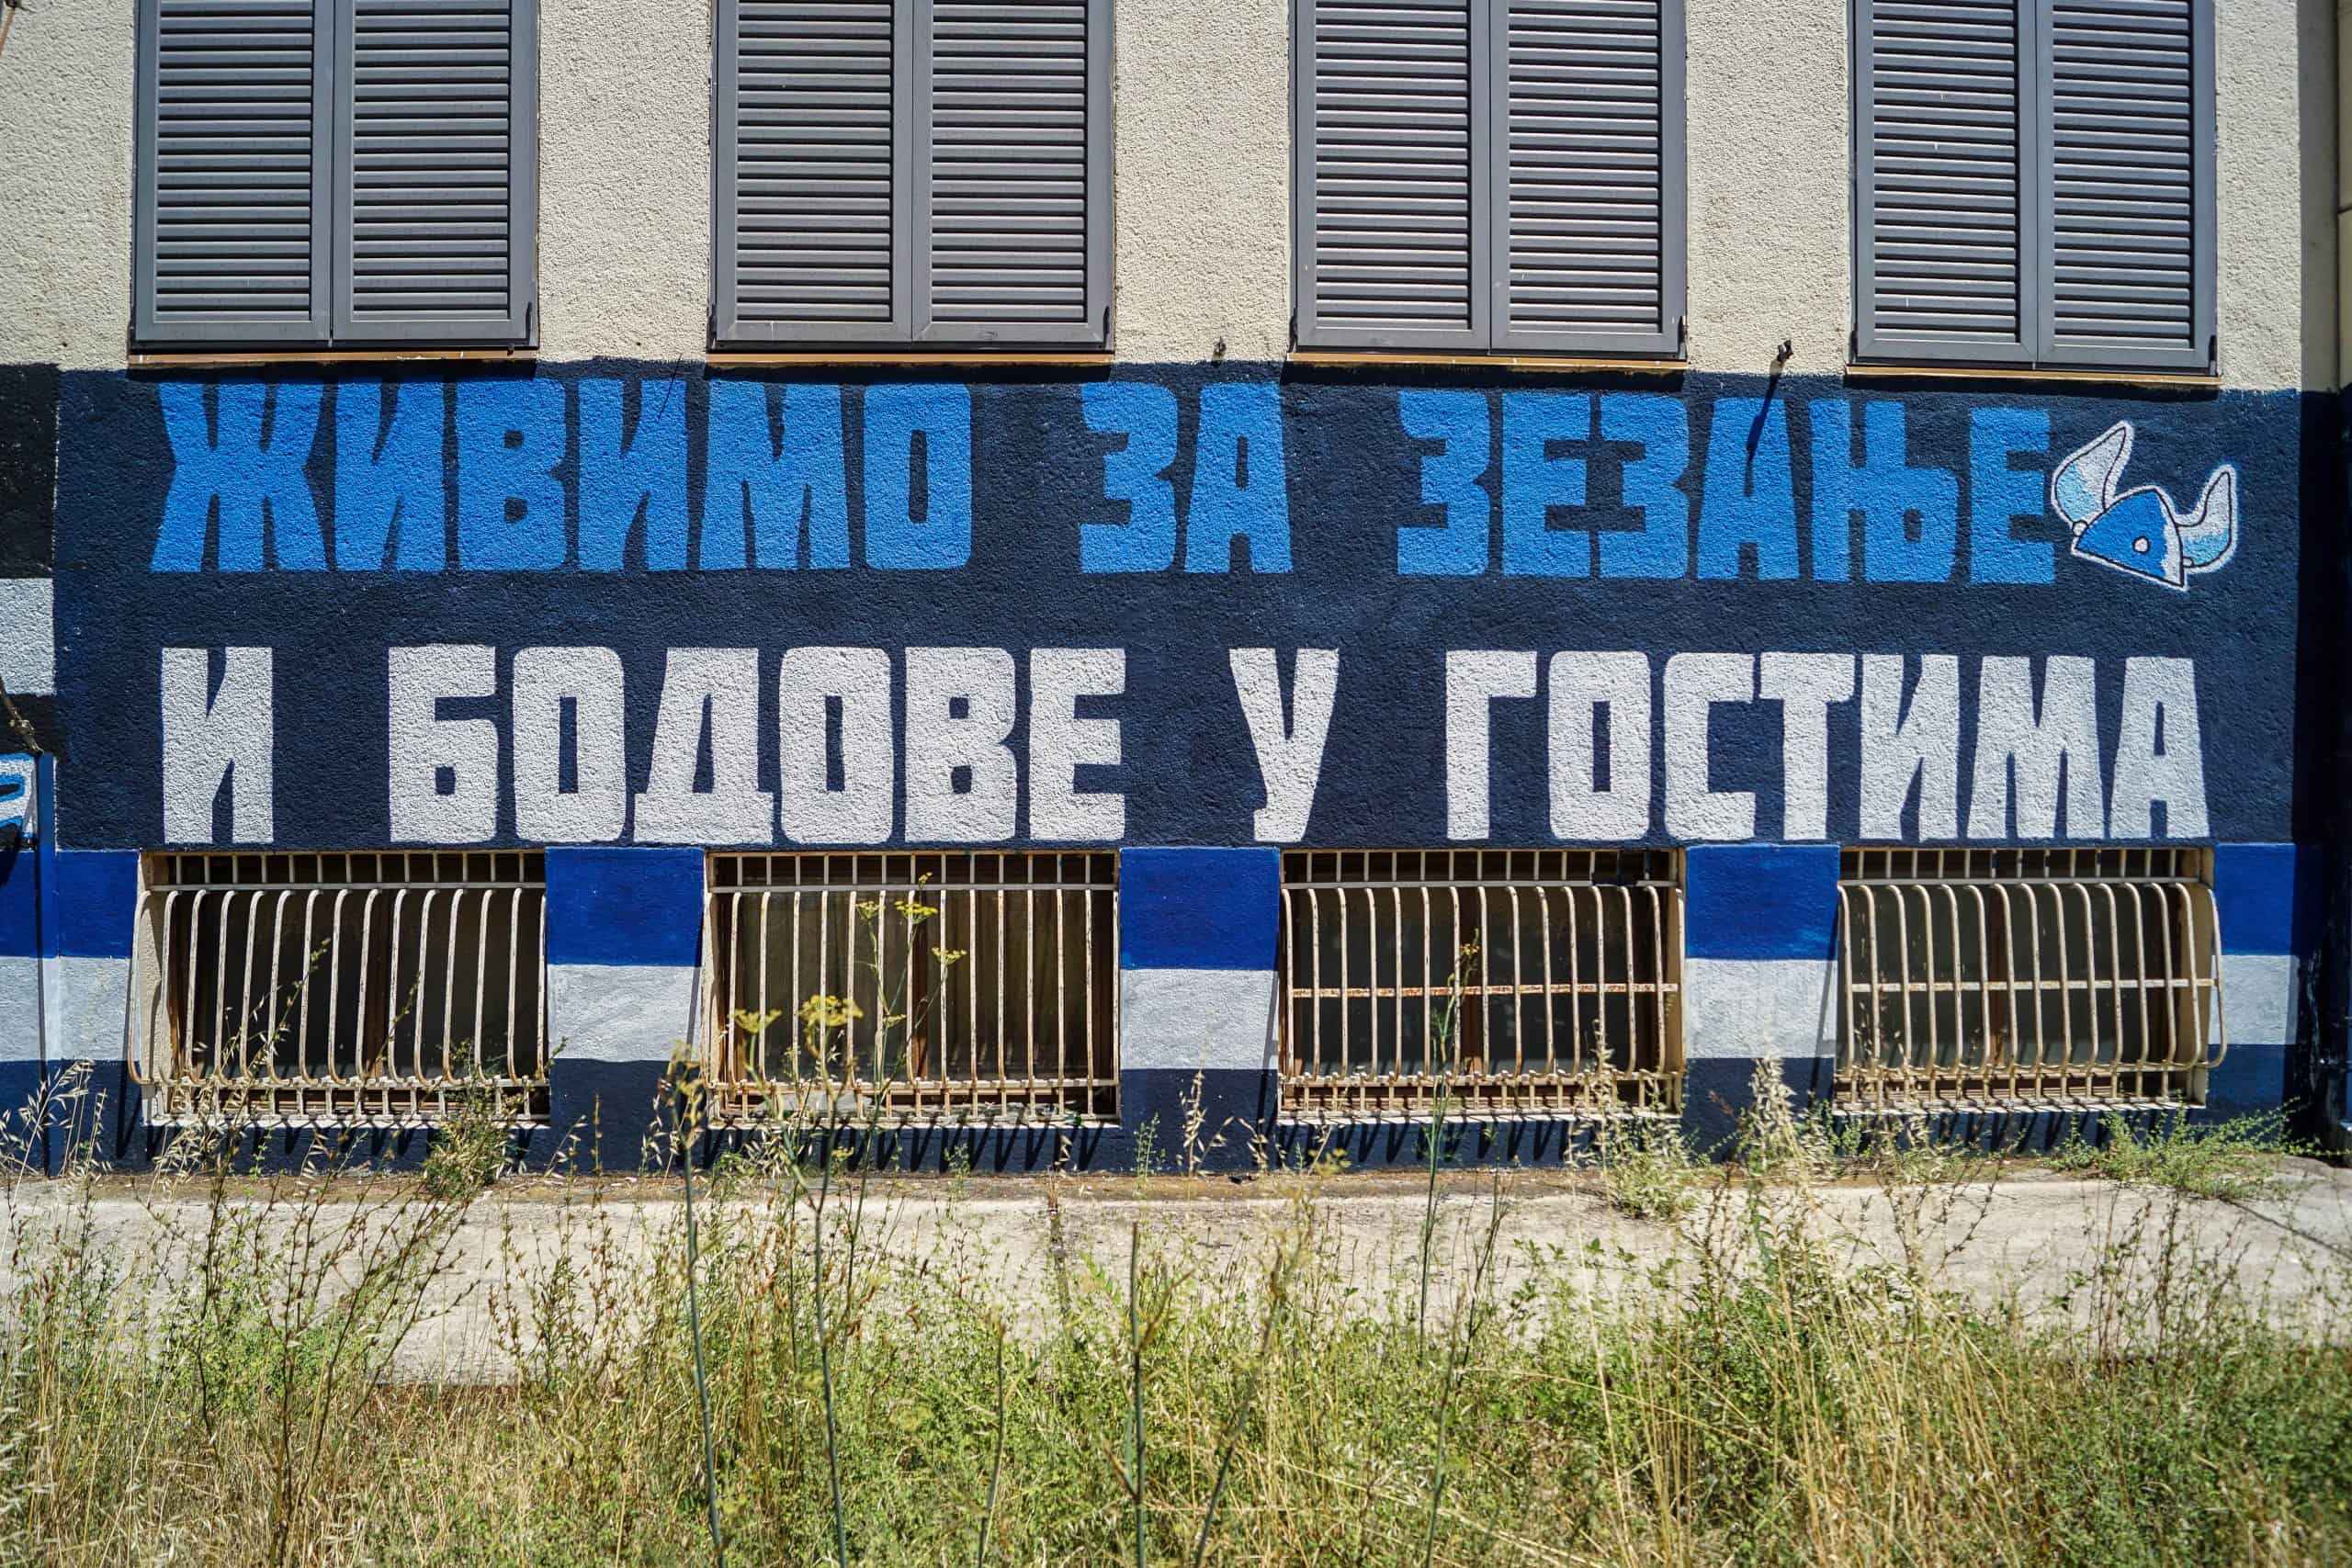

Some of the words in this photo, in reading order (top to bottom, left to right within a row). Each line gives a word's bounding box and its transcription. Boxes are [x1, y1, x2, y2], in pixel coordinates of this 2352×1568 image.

[150, 378, 972, 572] ЖИВИМО
[1080, 381, 1293, 574] ЗА
[1396, 389, 2056, 585] ЗЕЗАЊЕ
[160, 646, 274, 844] И
[388, 643, 1126, 845] БОДОВЕ
[1228, 647, 1340, 843] У
[1445, 649, 2210, 843] ГОСТИМА
